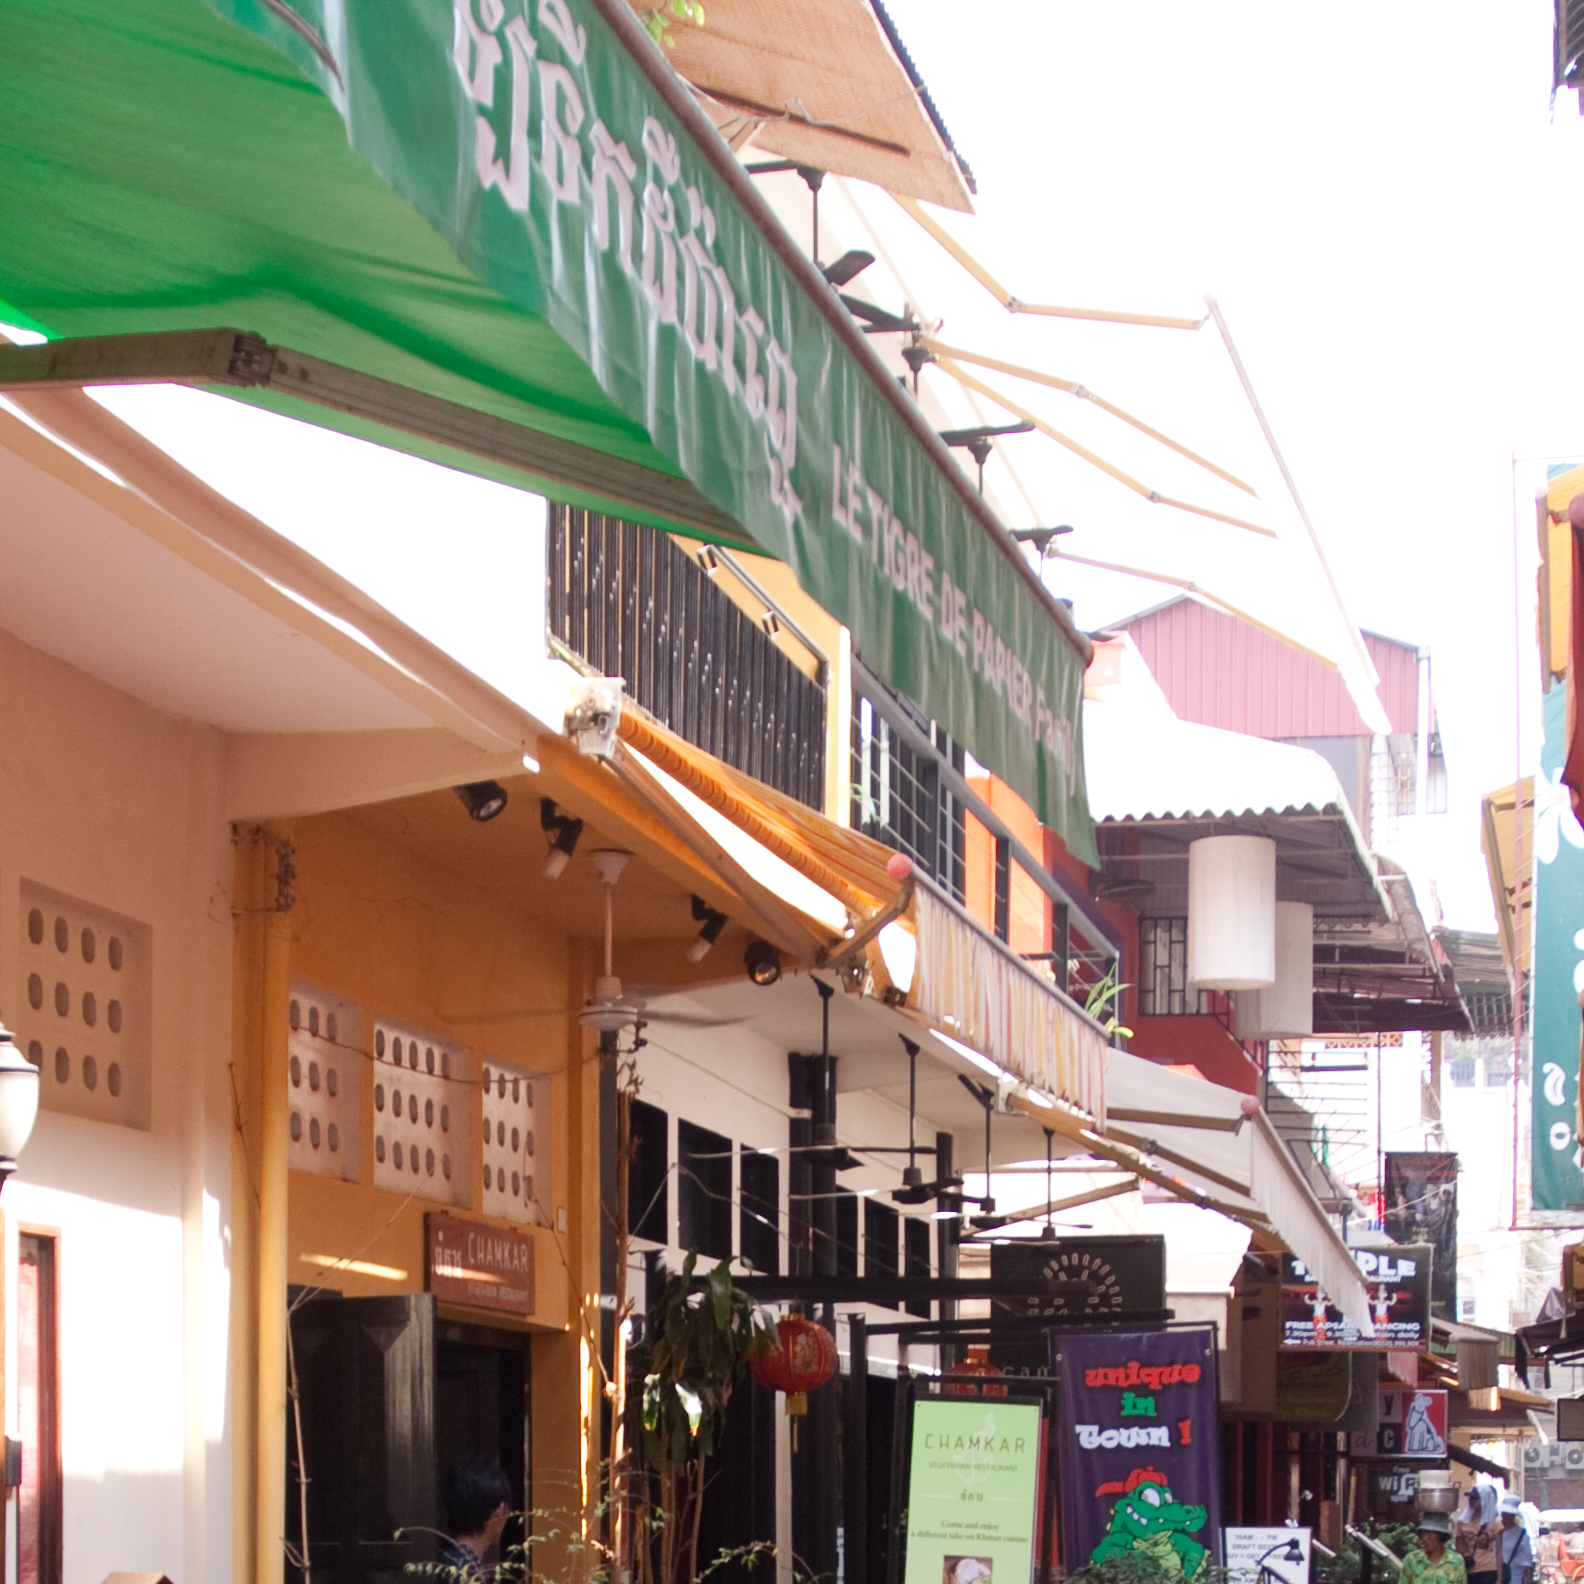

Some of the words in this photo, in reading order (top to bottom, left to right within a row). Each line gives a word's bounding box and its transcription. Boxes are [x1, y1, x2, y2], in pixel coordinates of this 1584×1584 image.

[832, 444, 863, 545] LE
[867, 486, 934, 623] TIGRE
[941, 570, 967, 658] DE
[973, 609, 1032, 731] PAPIER
[468, 1232, 528, 1272] CHAMKAR
[1285, 1321, 1314, 1330] FREE
[1373, 1322, 1420, 1331] ANCING
[1085, 1361, 1201, 1390] unique
[1121, 1392, 1157, 1416] in
[924, 1433, 1026, 1453] CHAMKAR
[1075, 1424, 1171, 1449] Town
[928, 1461, 971, 1470] VEGETARIAN
[973, 1462, 1018, 1472] RESTAURANT
[916, 1529, 948, 1539] different
[949, 1531, 963, 1540] take
[976, 1532, 1002, 1542] Khmer
[940, 1520, 963, 1529] Come
[964, 1522, 979, 1530] and
[979, 1523, 999, 1533] enjoy
